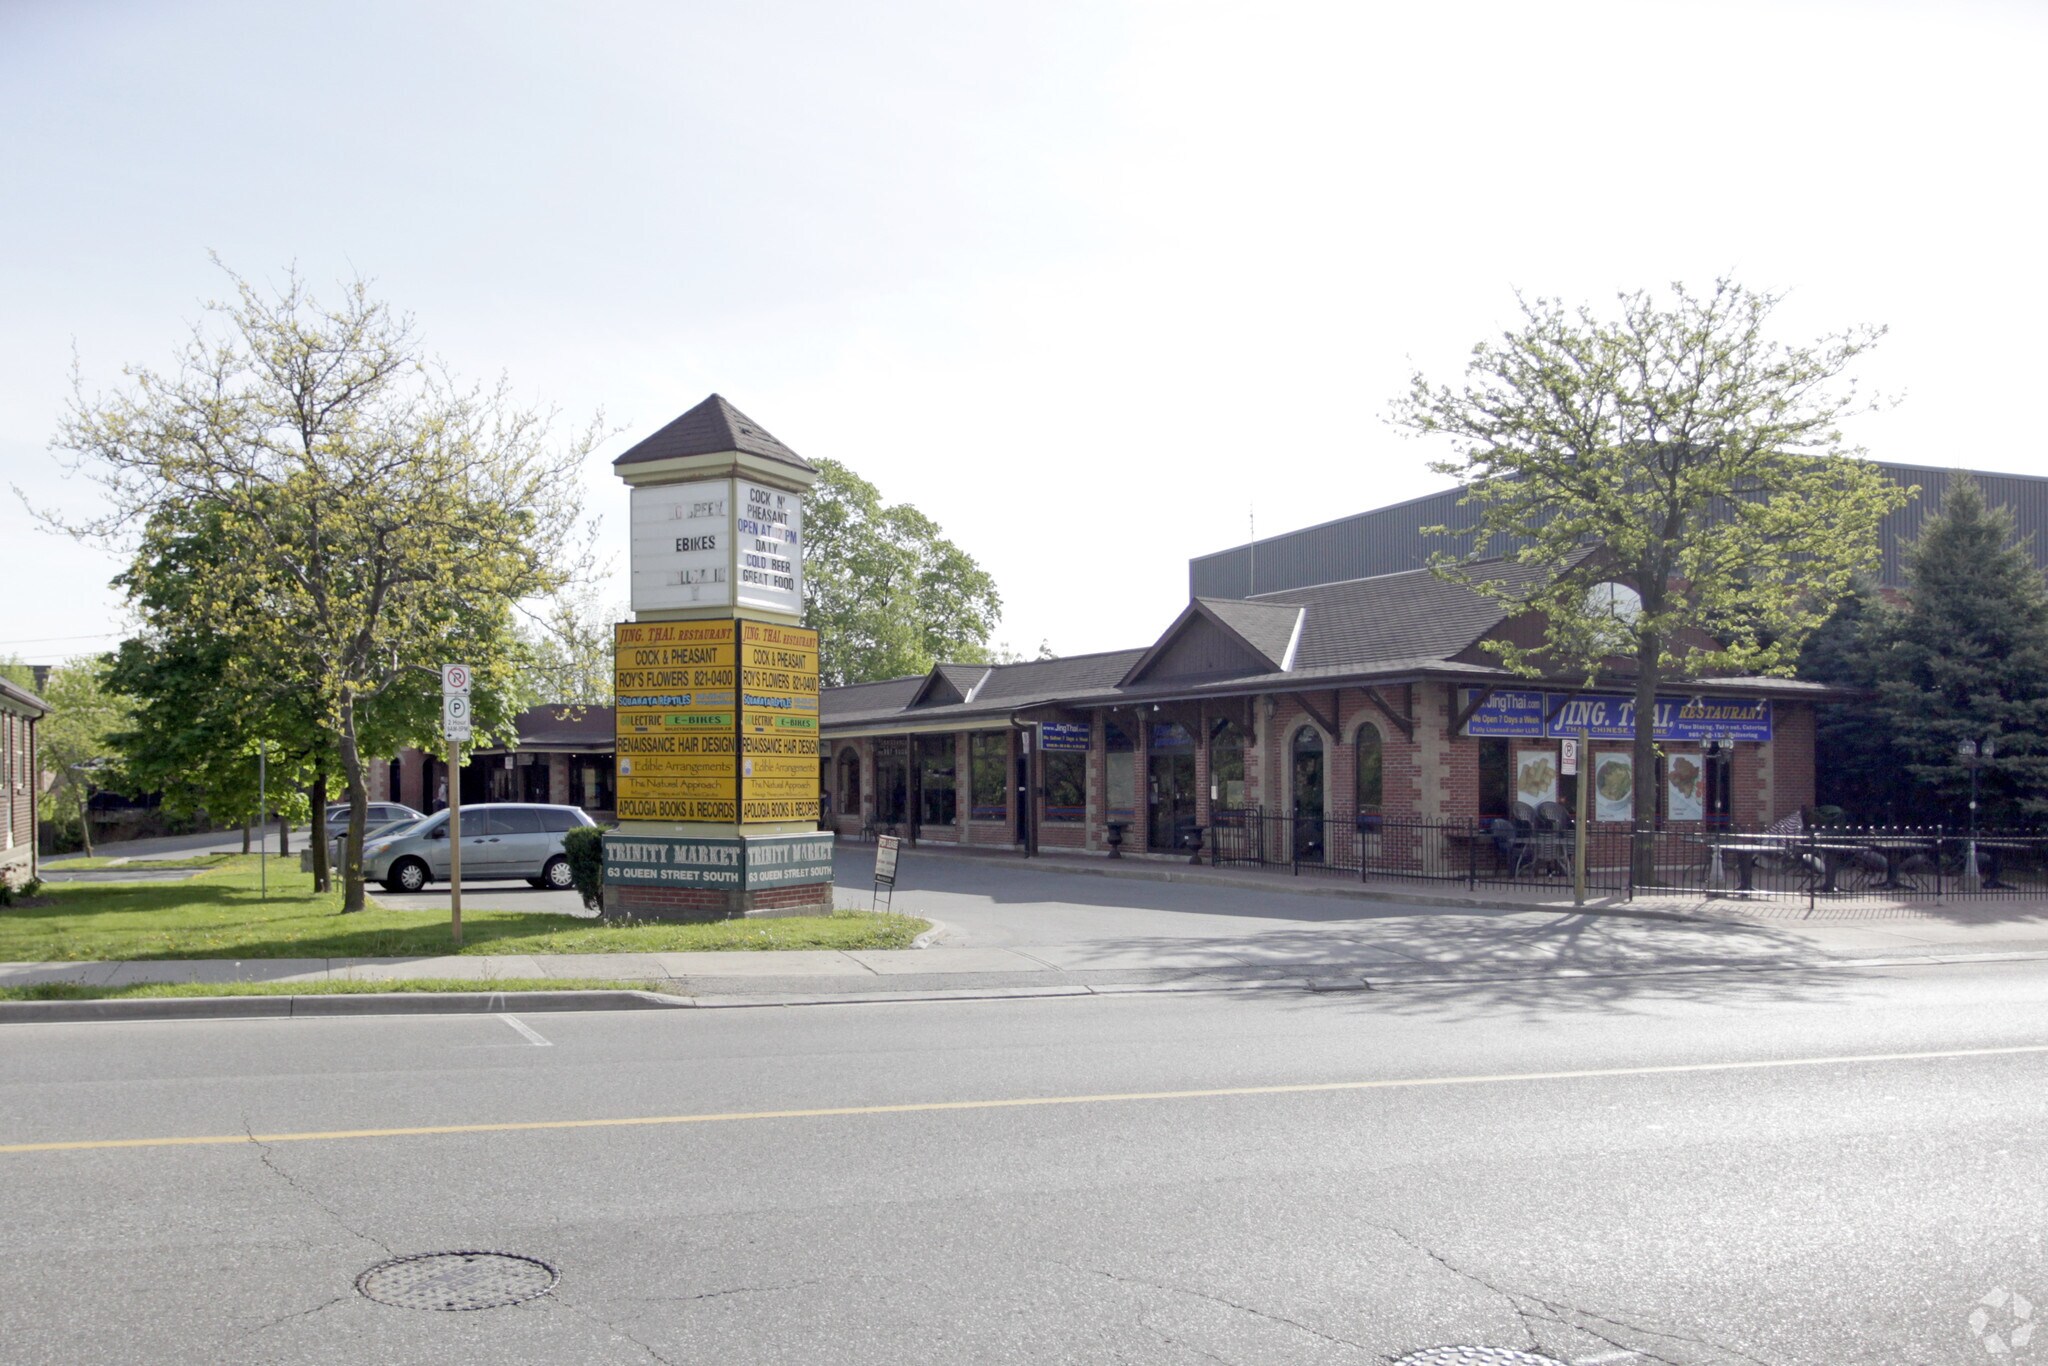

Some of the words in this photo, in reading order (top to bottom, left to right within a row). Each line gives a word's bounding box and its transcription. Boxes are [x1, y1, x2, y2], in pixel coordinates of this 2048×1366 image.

[750, 488, 771, 506] COCK
[747, 504, 788, 525] PHEASANT
[738, 518, 758, 535] OPEN
[761, 525, 771, 537] AT
[785, 529, 797, 544] PM
[676, 535, 716, 552] EBIKES
[746, 554, 766, 569] COLD
[771, 559, 791, 573] BEER
[743, 569, 768, 586] GREAT
[774, 575, 794, 590] FOOD
[678, 628, 733, 641] RESTAURANT
[783, 635, 816, 648] RESTAURANT
[635, 650, 659, 666] COCK
[662, 650, 669, 665] &
[671, 648, 718, 663] PHEASANT
[753, 649, 770, 665] COCK
[771, 652, 776, 666] &
[777, 652, 806, 669] PHEASANT
[619, 672, 643, 688] ROY'S
[646, 671, 689, 687] FLOWERS
[694, 669, 733, 686] 821-0400
[743, 671, 761, 687] ROY'S
[762, 672, 790, 689] FLOWERS
[792, 676, 816, 692] 821-0400
[659, 694, 691, 706] REPTILES
[1481, 693, 1540, 712] .JingThai.com
[674, 715, 721, 724] E-BIKES
[1482, 715, 1497, 724] Open
[1504, 715, 1518, 725] Days
[1679, 705, 1767, 720] RESTAURANT
[781, 718, 811, 727] E-BIKES
[617, 737, 675, 752] RENAISSANCE
[678, 737, 699, 752] HAIR
[702, 737, 735, 752] DESIGN
[743, 737, 781, 752] RENAISSANCE
[783, 738, 797, 753] HAIR
[798, 739, 819, 754] DESIGN
[634, 758, 663, 771] Edible
[665, 761, 731, 775] Arrangements
[754, 759, 774, 771] Edible
[775, 763, 816, 776] Arrangements
[629, 778, 645, 787] The
[647, 779, 678, 787] Natural
[680, 780, 721, 791] Approach
[763, 780, 783, 788] Natural
[785, 781, 810, 791] Approach
[619, 801, 657, 816] APOLOGIA
[659, 801, 686, 816] BOOKS
[689, 802, 694, 817] &
[697, 802, 735, 817] RECORDS
[744, 802, 770, 818] APOLOGIA
[771, 802, 789, 817] BOOKS
[795, 802, 819, 816] RECORDS
[605, 843, 669, 863] TRINITY
[674, 845, 740, 866] MARKET
[748, 844, 789, 865] TRINITY
[792, 842, 833, 862] MARKET
[607, 868, 620, 877] 63
[623, 868, 657, 879] QUEEN
[661, 870, 700, 881] STREET
[703, 871, 739, 882] SOUTH
[748, 872, 757, 882] 63
[759, 870, 783, 881] QUEEN
[784, 868, 809, 879] STREET
[810, 866, 832, 877] SOUTH
